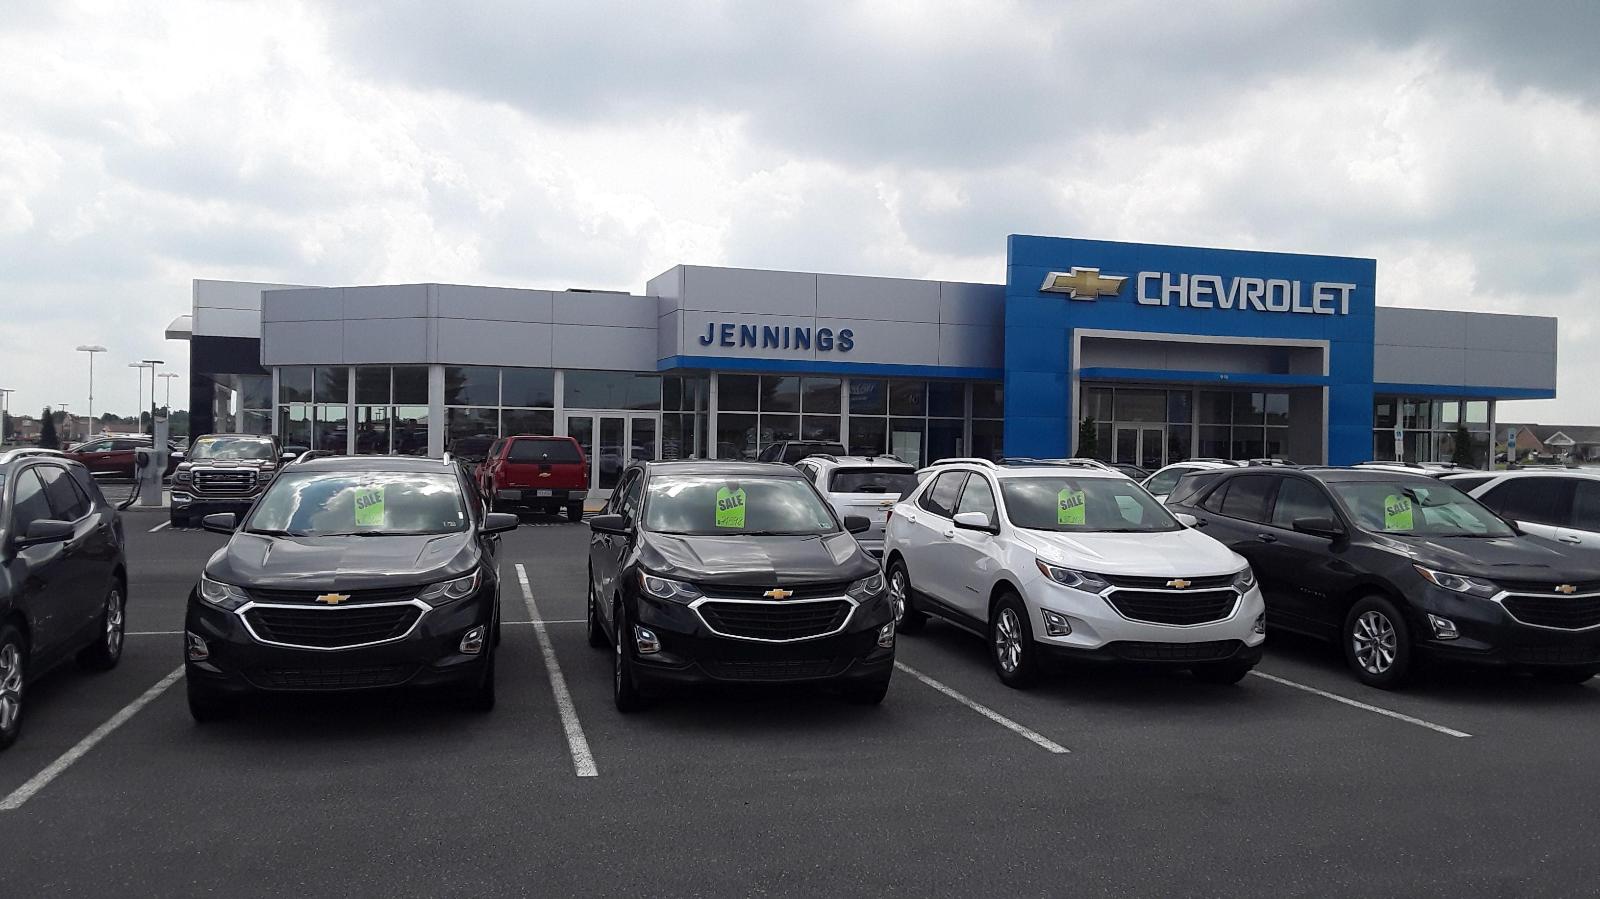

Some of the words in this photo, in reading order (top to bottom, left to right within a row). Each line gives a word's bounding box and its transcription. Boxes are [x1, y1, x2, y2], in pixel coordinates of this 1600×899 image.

[1137, 271, 1356, 315] CHEVROLET
[700, 322, 854, 351] JENNINGS
[357, 492, 382, 510] SALE
[719, 495, 743, 511] SALE
[1060, 495, 1084, 510] SALE
[1387, 501, 1410, 516] SALE
